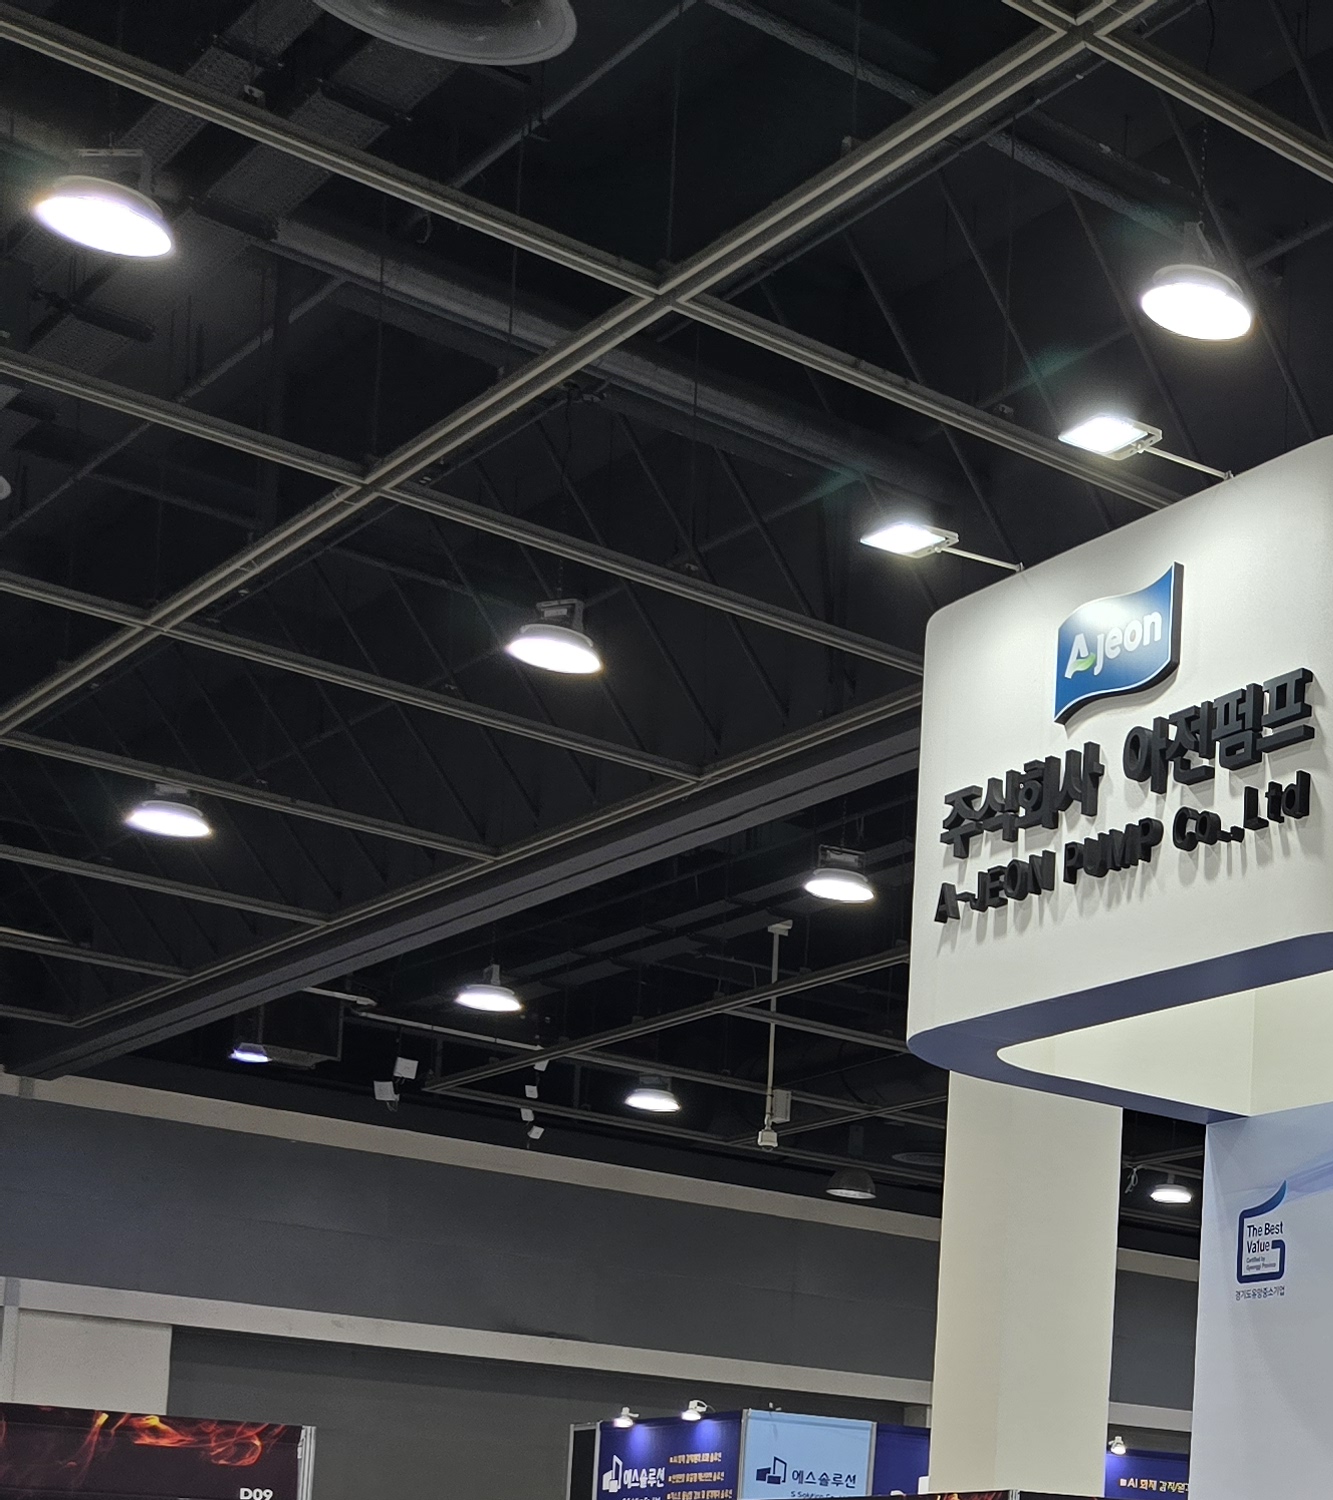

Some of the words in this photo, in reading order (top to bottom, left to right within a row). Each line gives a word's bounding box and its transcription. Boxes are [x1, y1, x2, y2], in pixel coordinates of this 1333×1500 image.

[1064, 609, 1163, 680] Ajeon
[940, 741, 1105, 859] 주식회사
[1123, 667, 1315, 795] 아전펌프
[934, 850, 1056, 924] A-JEON
[1063, 817, 1164, 884] PUMP
[1247, 1224, 1262, 1238] The
[1264, 1221, 1283, 1235] Best
[1247, 1240, 1270, 1254] Value
[623, 1467, 666, 1489] 에스솔루션
[791, 1468, 856, 1489] 에스솔루션
